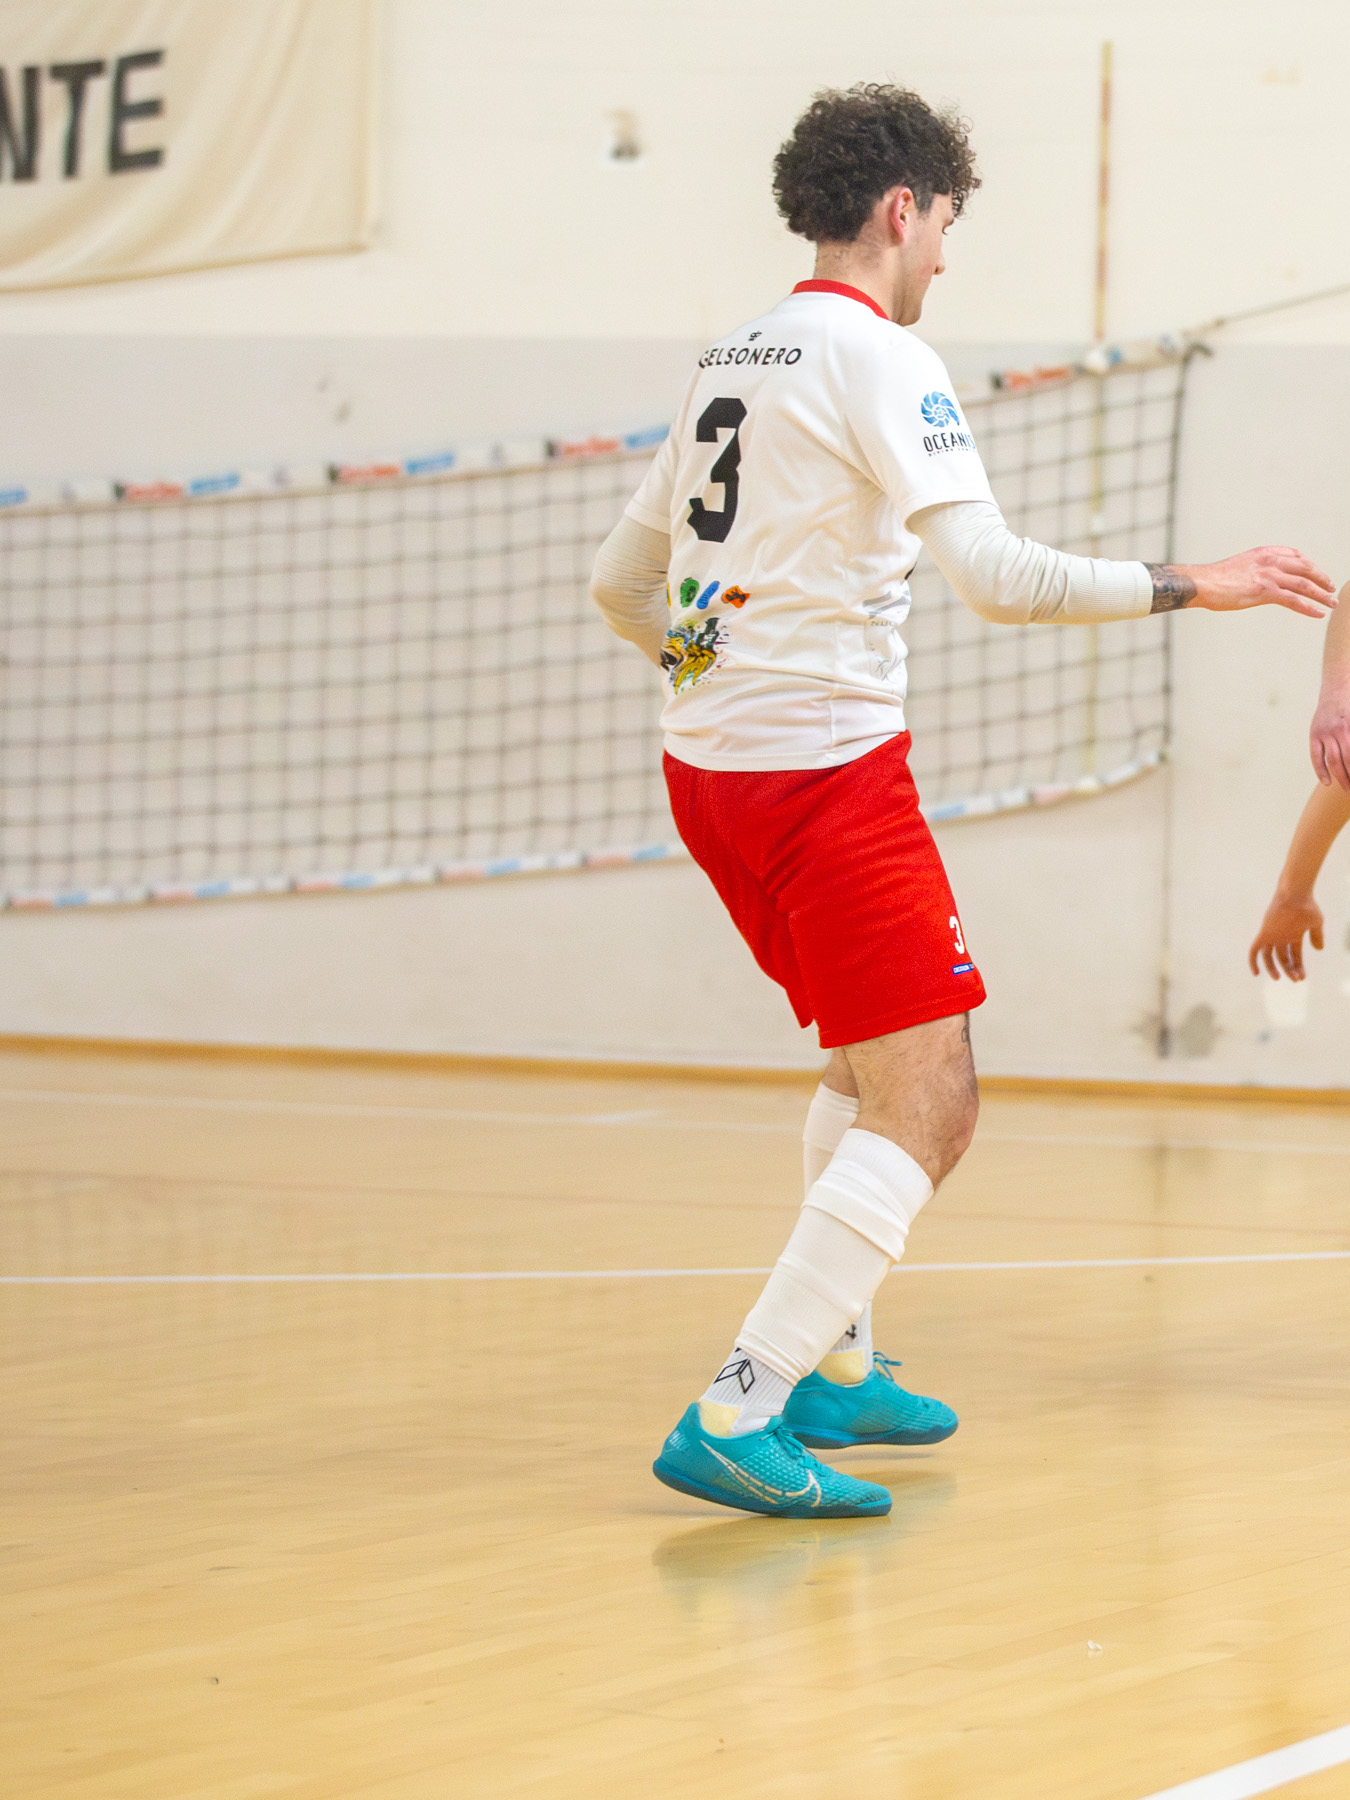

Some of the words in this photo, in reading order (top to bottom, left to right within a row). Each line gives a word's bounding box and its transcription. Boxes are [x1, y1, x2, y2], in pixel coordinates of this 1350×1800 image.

[698, 347, 802, 369] GELSONERO
[687, 397, 747, 543] 3
[949, 915, 965, 954] 3
